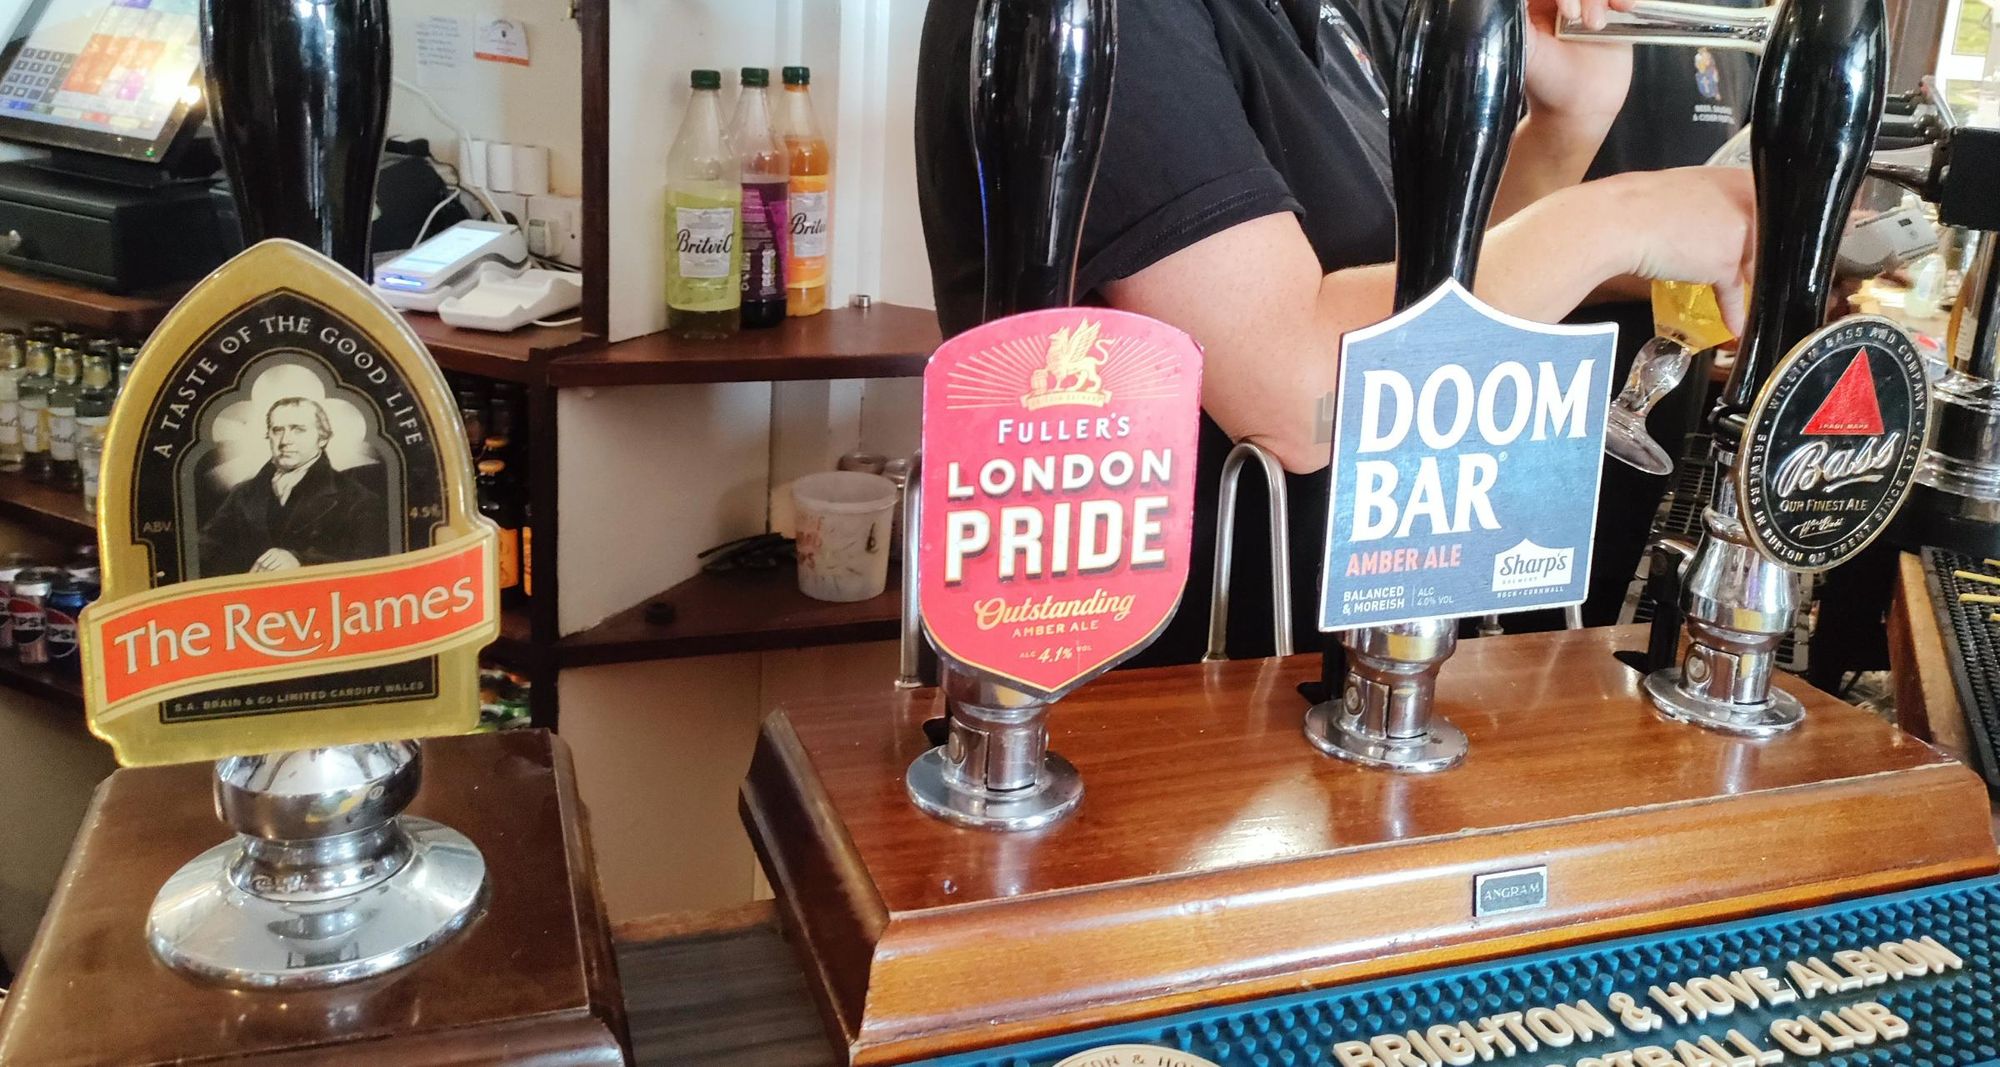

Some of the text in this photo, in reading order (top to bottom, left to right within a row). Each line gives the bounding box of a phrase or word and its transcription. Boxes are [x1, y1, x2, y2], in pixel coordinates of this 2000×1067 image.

[154, 314, 424, 458] A TASTE OF THE GOOD LIFE
[1768, 327, 1925, 411] WILLIAM BASS AND COMPANY
[1357, 358, 1596, 453] DOOM
[998, 413, 1131, 444] FULLER'S
[1750, 433, 1767, 506] BREWERS
[1772, 431, 1900, 498] Bass
[1902, 435, 1920, 470] 1777
[947, 448, 1173, 500] LONDON
[1348, 453, 1502, 542] BAR
[1875, 480, 1906, 522] SINCE
[143, 521, 172, 533] ABV
[1753, 510, 1767, 526] IN
[944, 496, 1169, 586] PRIDE
[1762, 528, 1804, 562] BURTON
[1808, 551, 1826, 564] ON
[1832, 524, 1873, 557] TRENT
[1345, 543, 1462, 577] AMBER ALE
[1500, 553, 1568, 578] Sharp's
[1342, 598, 1406, 616] & MOREISH
[1343, 586, 1405, 602] BALANCED
[1417, 586, 1435, 598] ALC
[1438, 595, 1455, 605] VOL
[114, 575, 475, 675] The Rev. James
[973, 588, 1137, 631] Outstanding
[1012, 619, 1099, 638] AMBER ALE
[1037, 646, 1073, 664] 4.1%
[277, 690, 328, 703] LIMITED
[330, 685, 382, 698] CARDIFF
[384, 680, 425, 693] WALES
[1484, 881, 1541, 901] ANGRAM
[1333, 935, 1963, 1067] BRIGHTON & HOVE ALBION
[1769, 1001, 1910, 1057] CLUB
